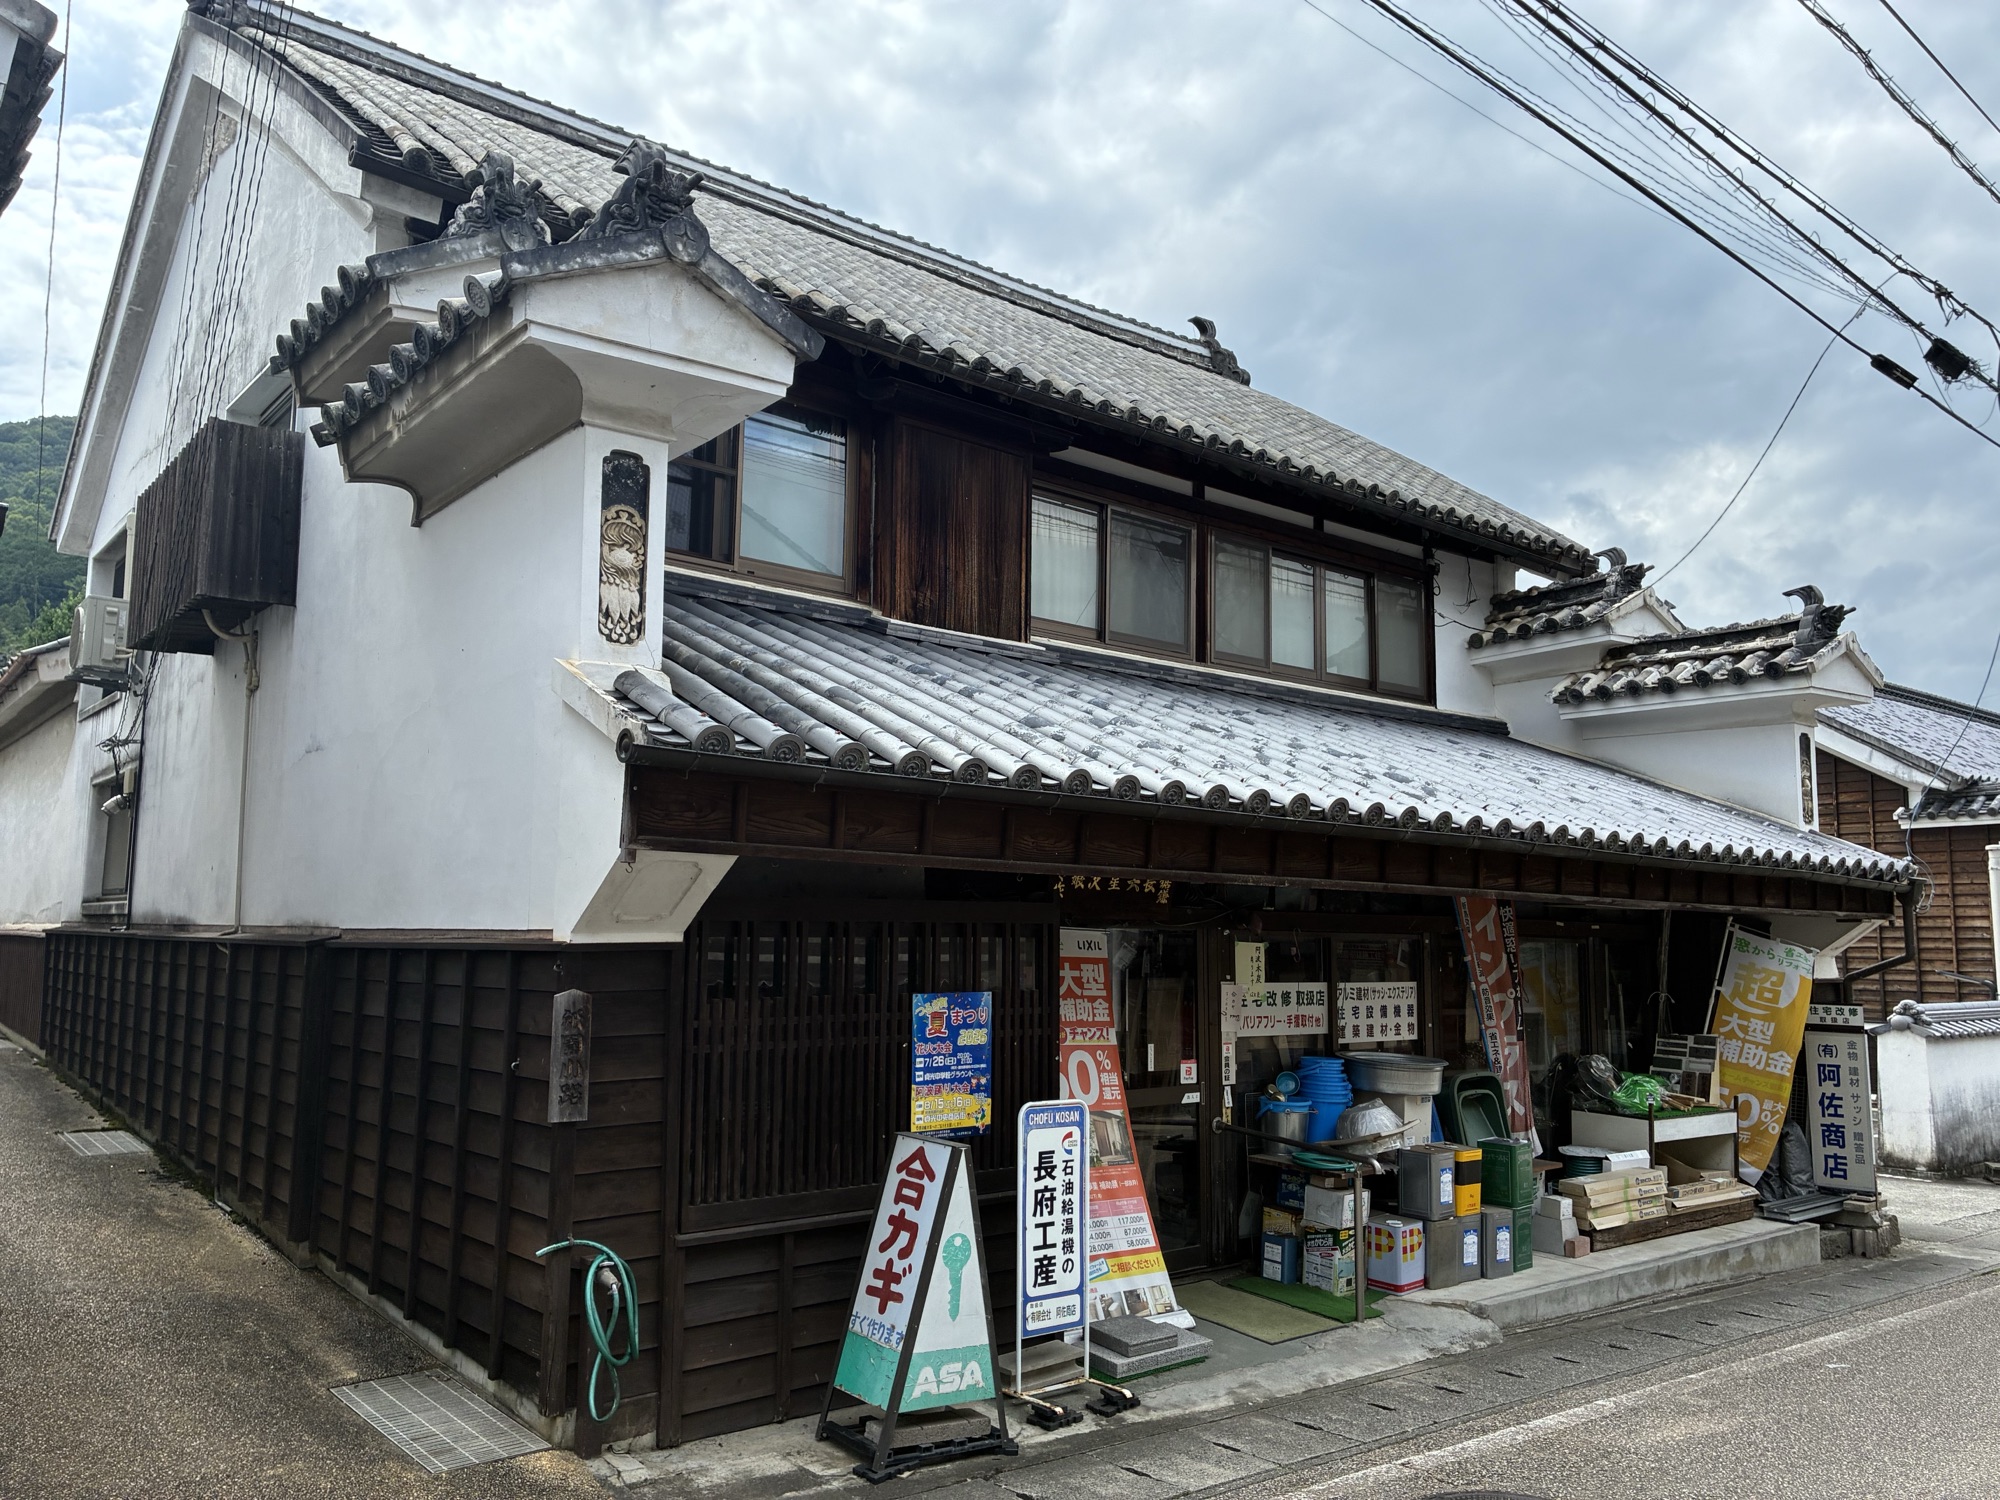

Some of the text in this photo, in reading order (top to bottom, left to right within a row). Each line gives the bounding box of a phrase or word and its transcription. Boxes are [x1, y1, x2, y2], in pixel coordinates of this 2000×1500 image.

[1077, 939, 1103, 951] LIXIL
[1733, 936, 1776, 961] 窓から
[1784, 946, 1811, 963] 省エネ
[1060, 962, 1108, 997] 大型
[1728, 961, 1788, 1015] 超
[1060, 998, 1111, 1023] 補助金
[1337, 1003, 1415, 1021] 住宅設備機器
[1475, 903, 1526, 1117] インプラス
[1809, 1006, 1859, 1018] 住宅改修
[1819, 1016, 1850, 1025] 取扱店
[1240, 1012, 1325, 1031] バリアフリー・手摺取付他)
[1718, 1012, 1776, 1046] 大型
[956, 1028, 989, 1047] 2026
[1069, 1027, 1110, 1042] チャンス!
[915, 1041, 954, 1056] 花火大会
[1717, 1034, 1794, 1077] 補助金
[1817, 1043, 1839, 1059] (有)
[1846, 1039, 1858, 1062] 金物
[1100, 1072, 1119, 1086] 相当
[1848, 1065, 1860, 1088] 建材
[1102, 1087, 1122, 1100] 還元
[1762, 1098, 1785, 1115] 最大
[1850, 1092, 1862, 1126] サッシ
[1029, 1110, 1080, 1126] CHOFU KOSAN
[1816, 1062, 1849, 1181] 阿佐商店
[1032, 1149, 1058, 1289] 長府工産
[1060, 1158, 1075, 1275] 石油給湯機の
[865, 1145, 936, 1316] 合カギ
[1110, 1256, 1160, 1275] ご相談ください!
[1030, 1304, 1077, 1324] 有限会社 阿佐商店
[850, 1311, 905, 1350] すぐ作ります
[911, 1360, 985, 1400] ASA
